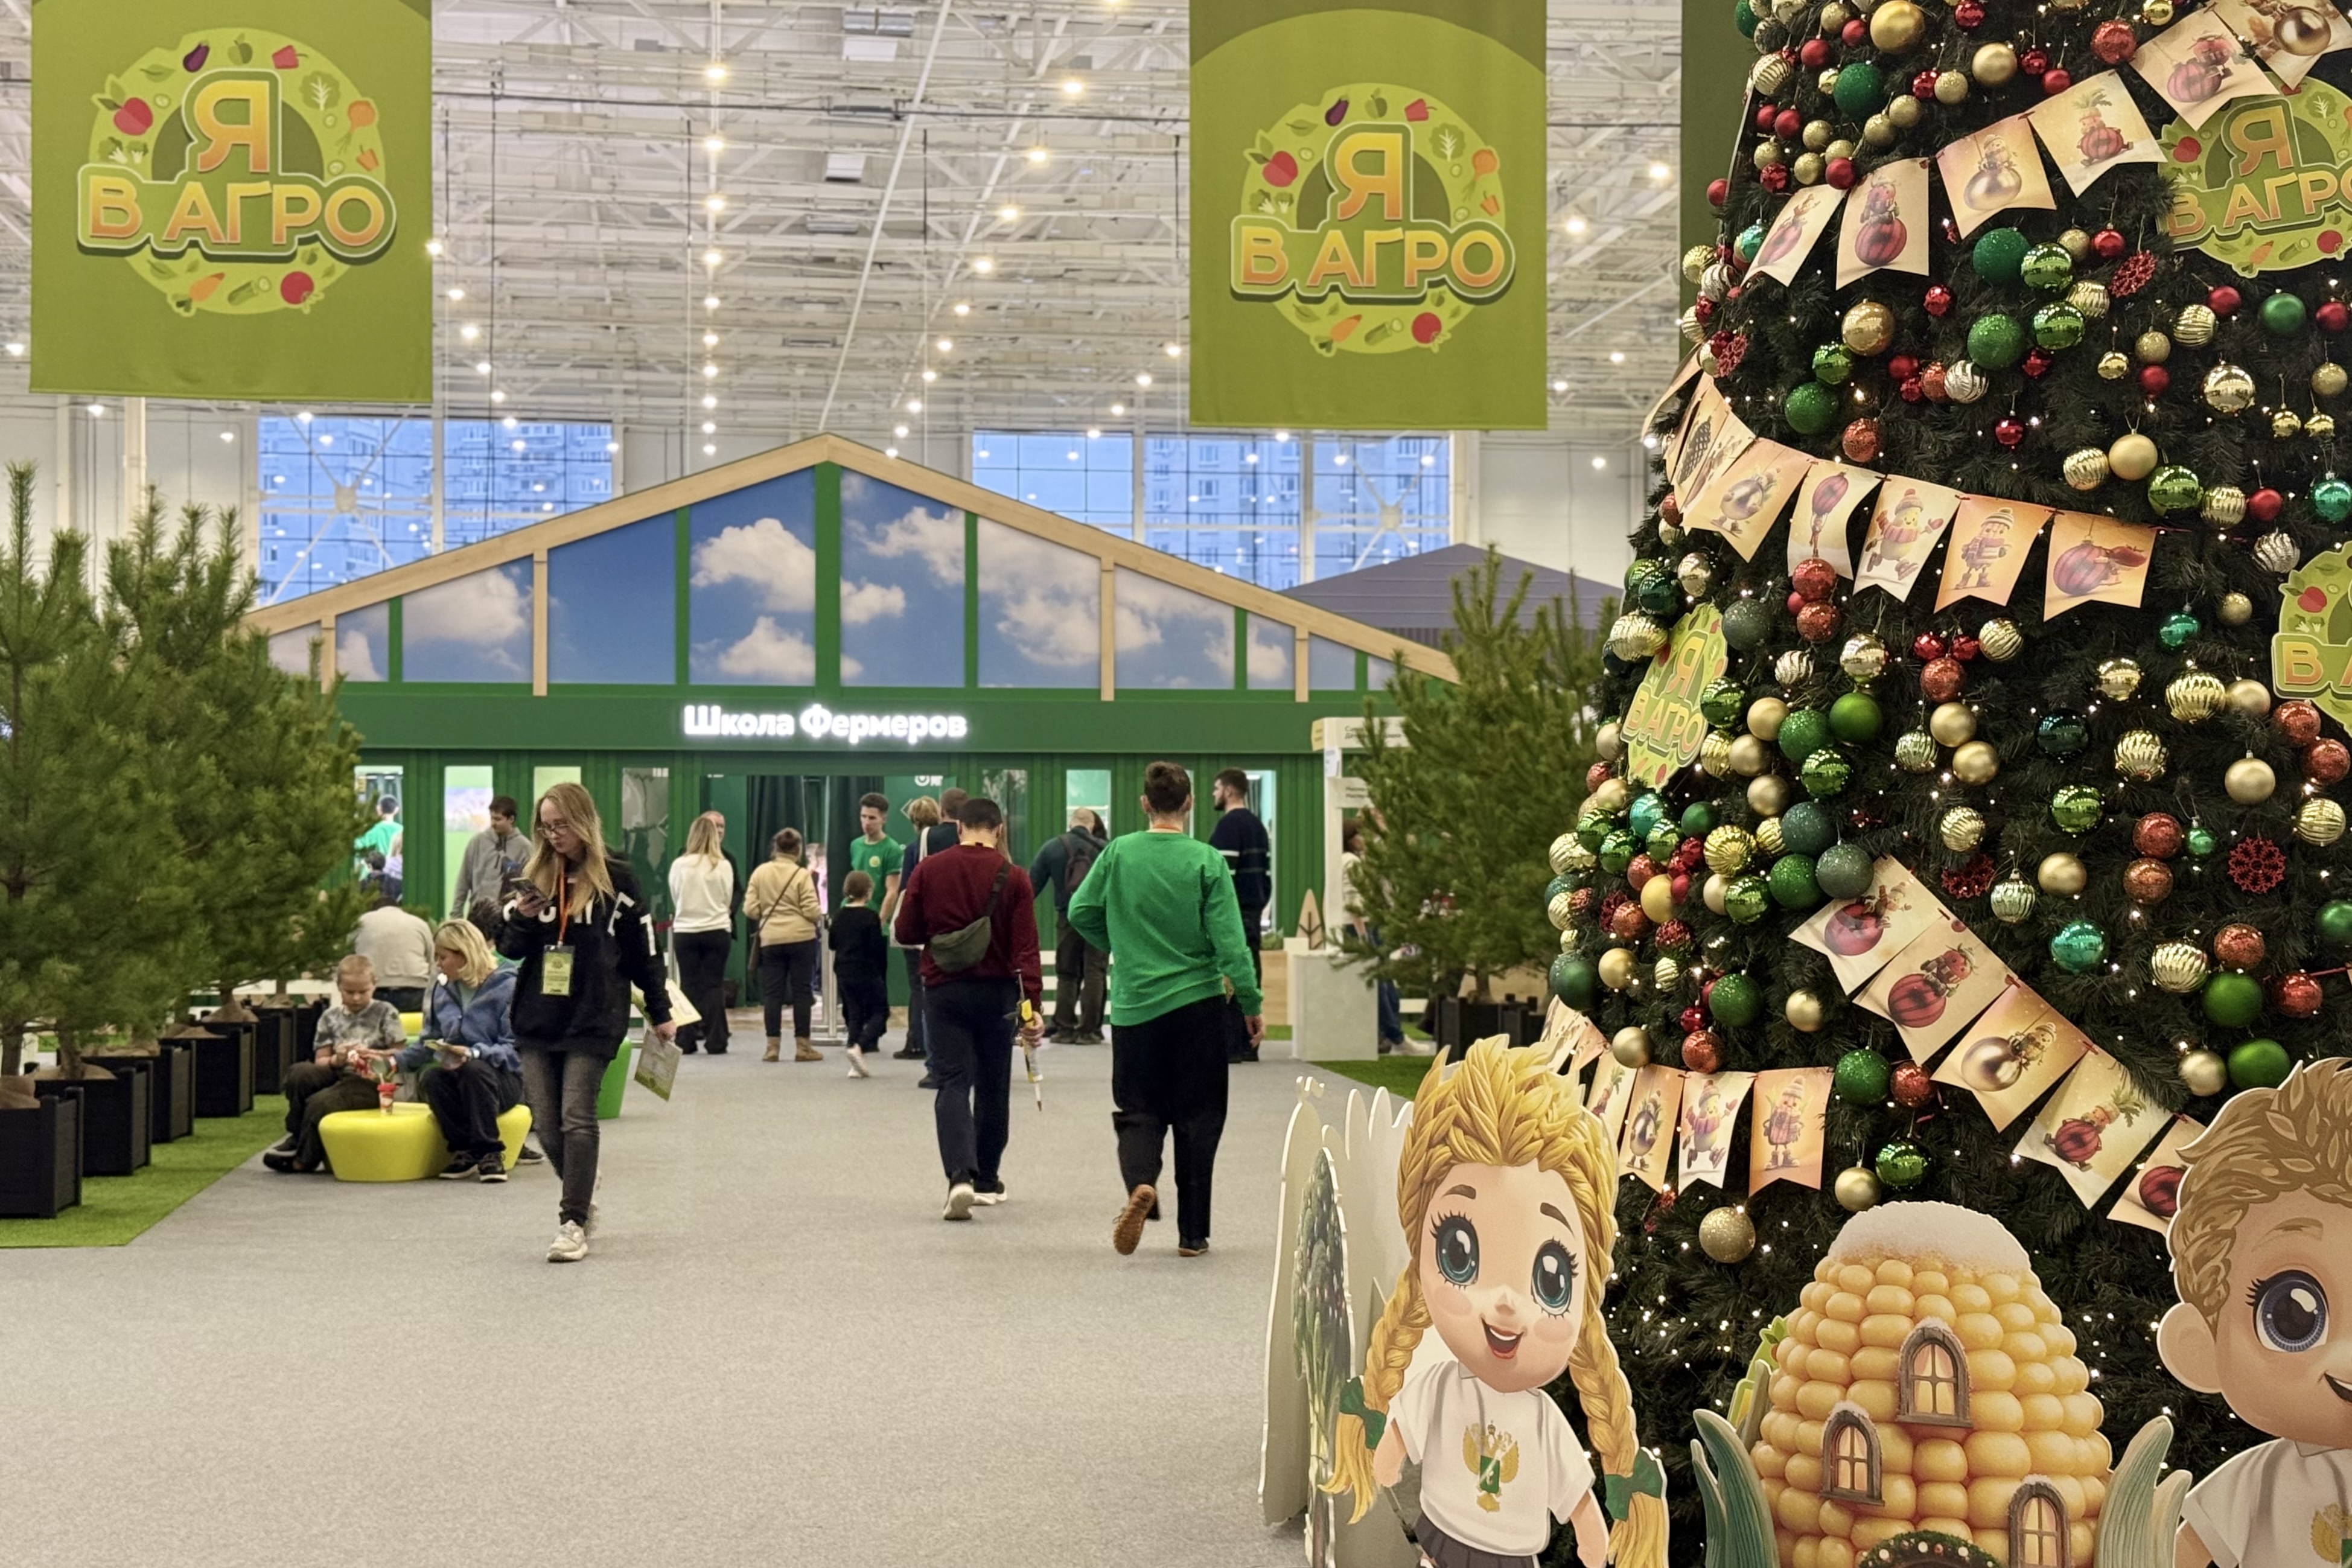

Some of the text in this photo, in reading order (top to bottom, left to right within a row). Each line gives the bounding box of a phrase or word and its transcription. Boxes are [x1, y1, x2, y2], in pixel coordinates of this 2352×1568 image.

[194, 79, 270, 173] Я
[2229, 105, 2294, 176] Я
[1334, 132, 1403, 221] Я
[2167, 170, 2352, 237] В АГР
[89, 175, 386, 247] В АГРО
[1241, 225, 1506, 288] В АГРО
[1666, 636, 1706, 700] Я
[2282, 641, 2324, 685] В
[684, 703, 967, 744] Школа Фермеров
[1627, 689, 1703, 753] В АГРО
